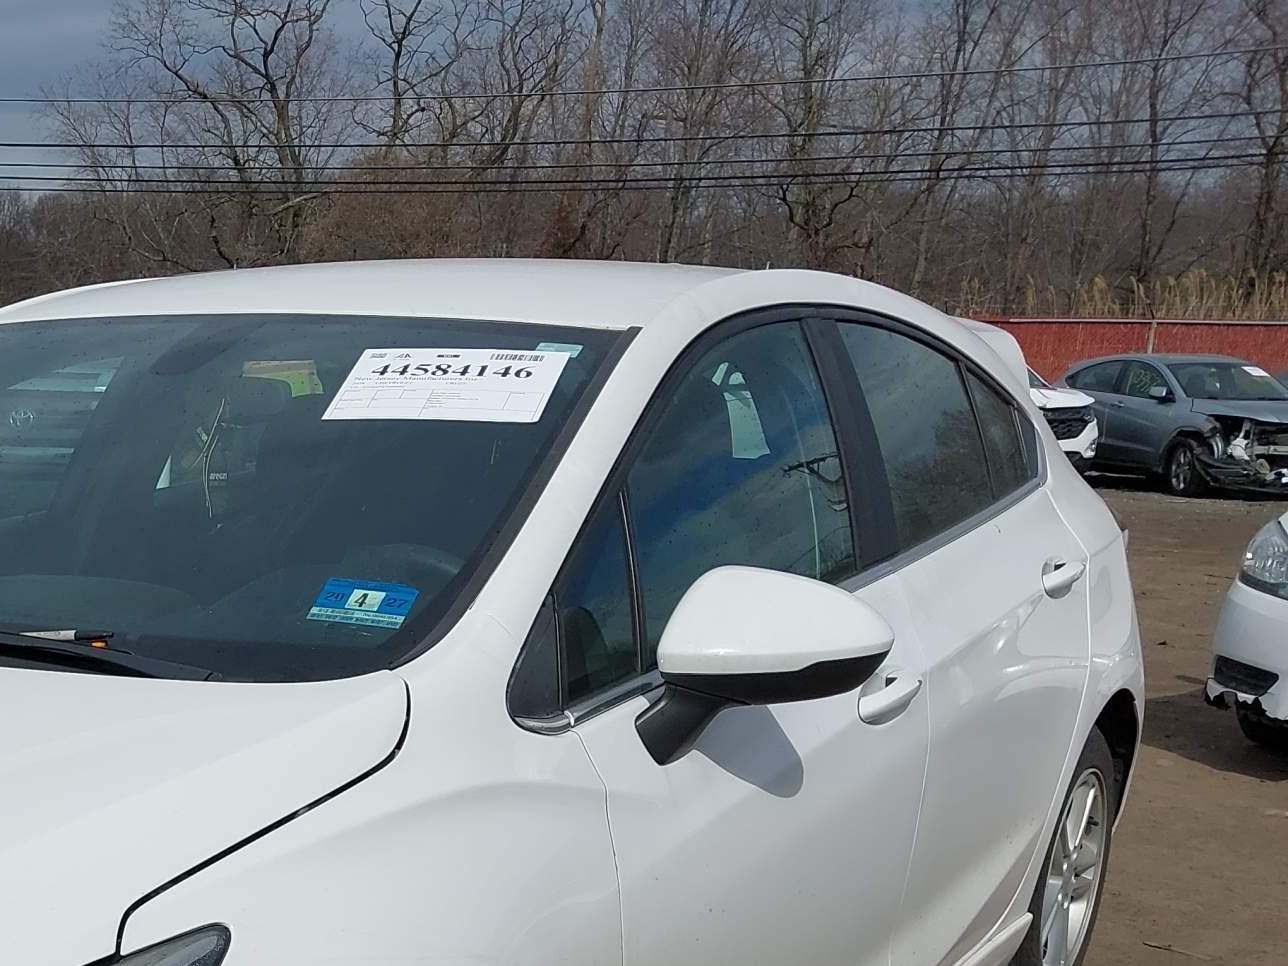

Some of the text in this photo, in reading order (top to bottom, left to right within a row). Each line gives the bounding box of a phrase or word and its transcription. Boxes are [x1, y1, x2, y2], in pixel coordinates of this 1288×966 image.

[371, 363, 536, 378] 44584146
[324, 592, 409, 609] 20 4 27
